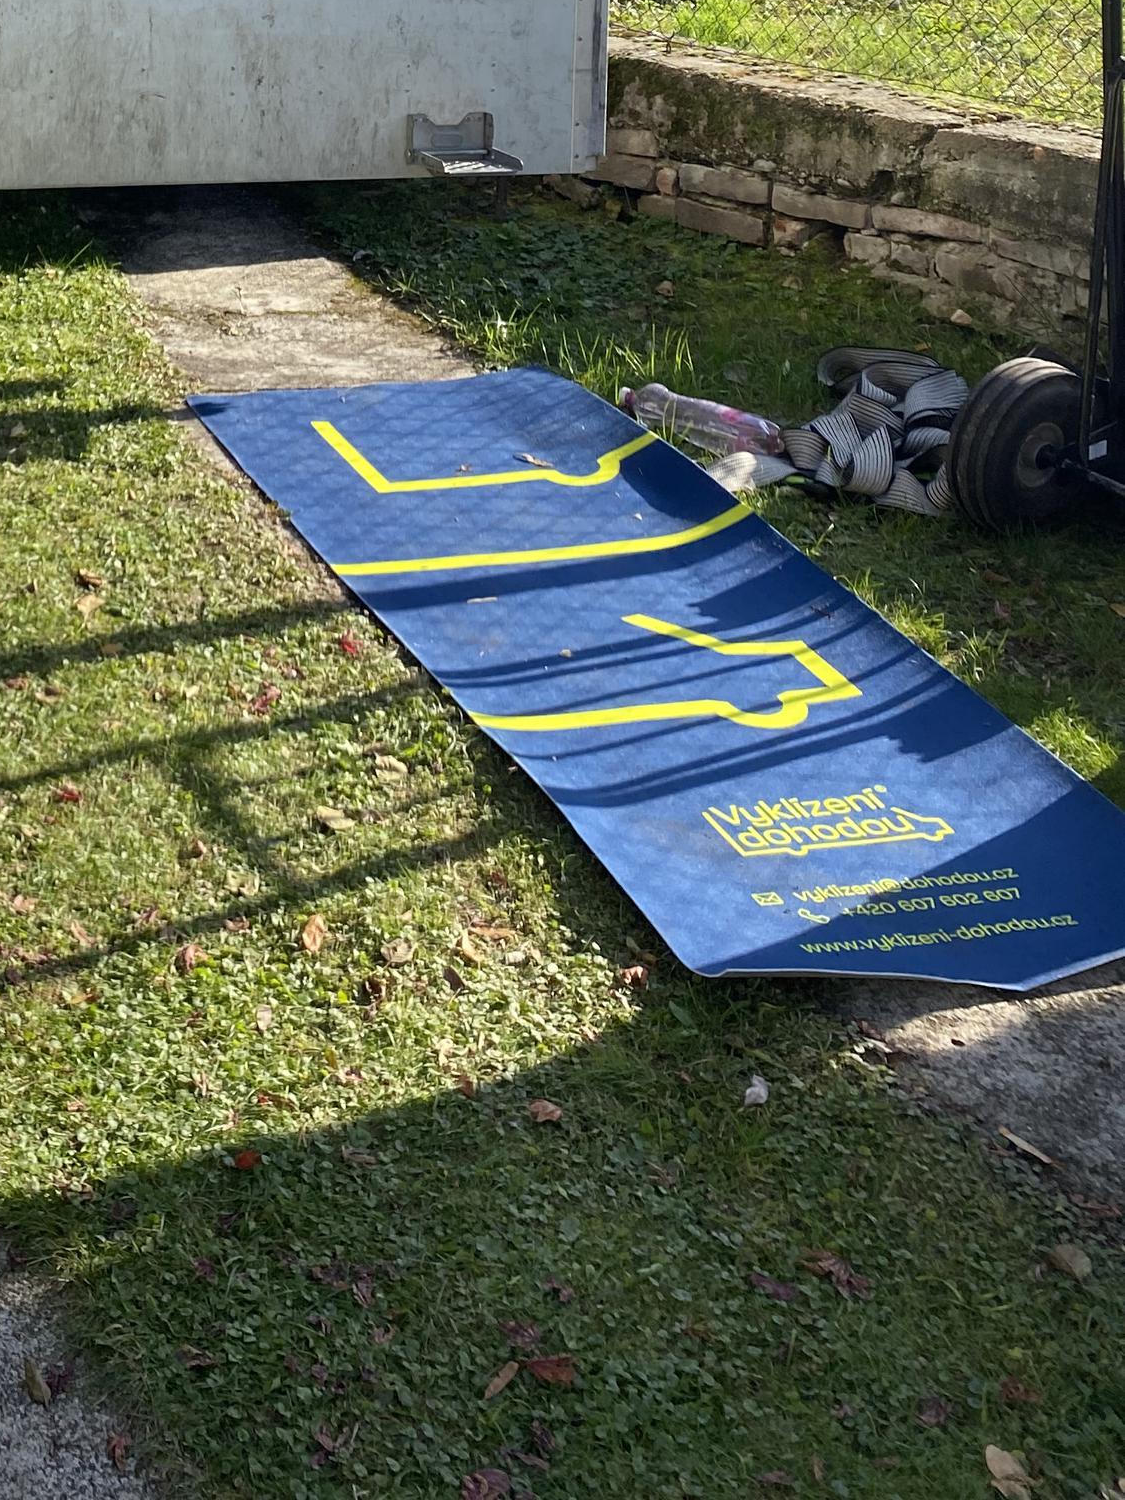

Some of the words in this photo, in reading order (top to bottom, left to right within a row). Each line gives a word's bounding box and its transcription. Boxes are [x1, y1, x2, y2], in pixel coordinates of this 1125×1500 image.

[737, 814, 916, 848] dohodou
[792, 868, 1020, 903] vyklizeni@dohodou.cz
[842, 902, 896, 917] +420
[898, 897, 935, 912] 607
[939, 892, 984, 907] 602
[982, 887, 1020, 902] 607
[800, 914, 1078, 954] www.vyklizeni-dohodou.cz
